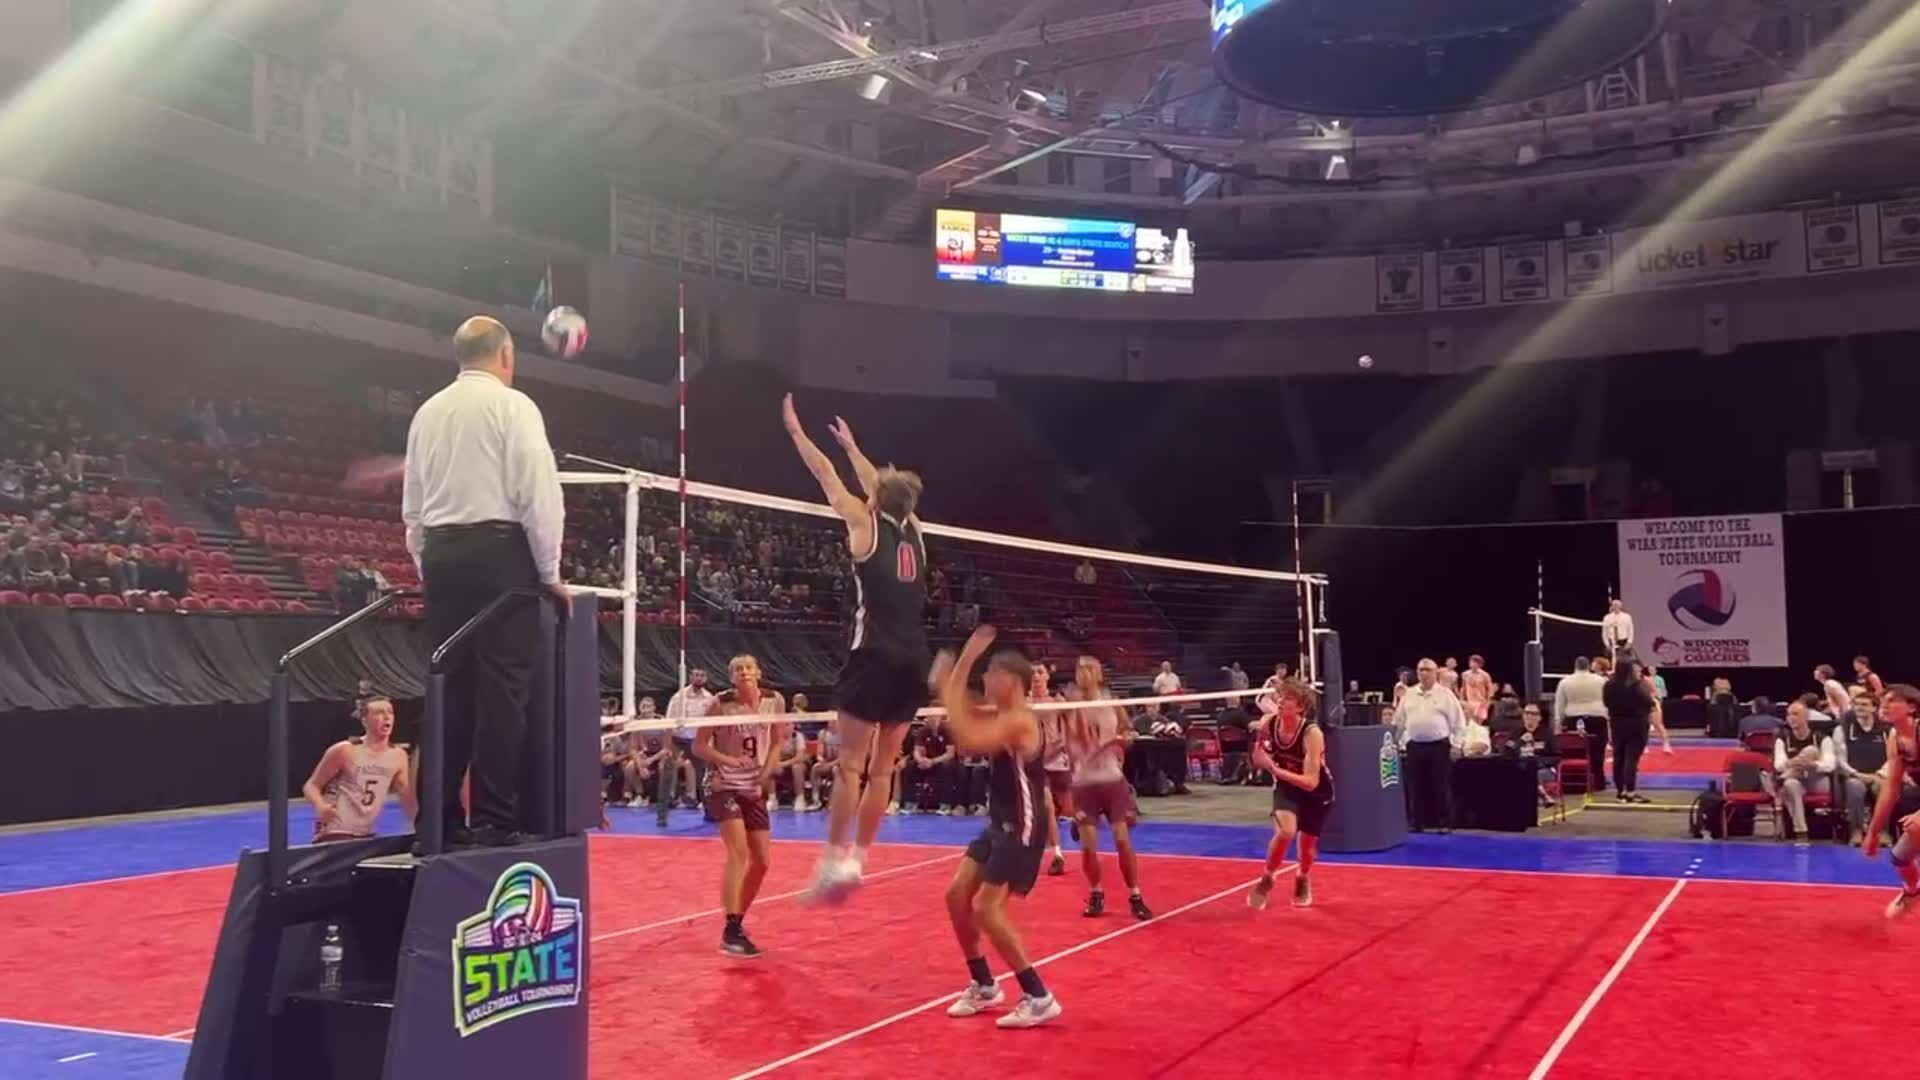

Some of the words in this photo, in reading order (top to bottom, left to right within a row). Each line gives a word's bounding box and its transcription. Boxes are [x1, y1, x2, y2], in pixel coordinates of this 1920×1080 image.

[1724, 237, 1780, 265] star
[1644, 520, 1705, 535] WELCOME
[1706, 519, 1725, 534] TO
[1726, 518, 1751, 532] THE
[1627, 537, 1657, 551] WIAA
[1660, 535, 1697, 550] STATE
[1697, 533, 1775, 548] VOLLEYBALL
[1658, 550, 1742, 566] TOURNAMENT
[1683, 639, 1750, 647] WISCONSIN
[1684, 653, 1751, 663] COACHES
[742, 736, 758, 758] 9
[360, 779, 379, 807] 5
[464, 930, 576, 1007] STATE
[465, 993, 521, 1023] VOLLEYBALL
[521, 983, 575, 1002] TOURNAMENT
